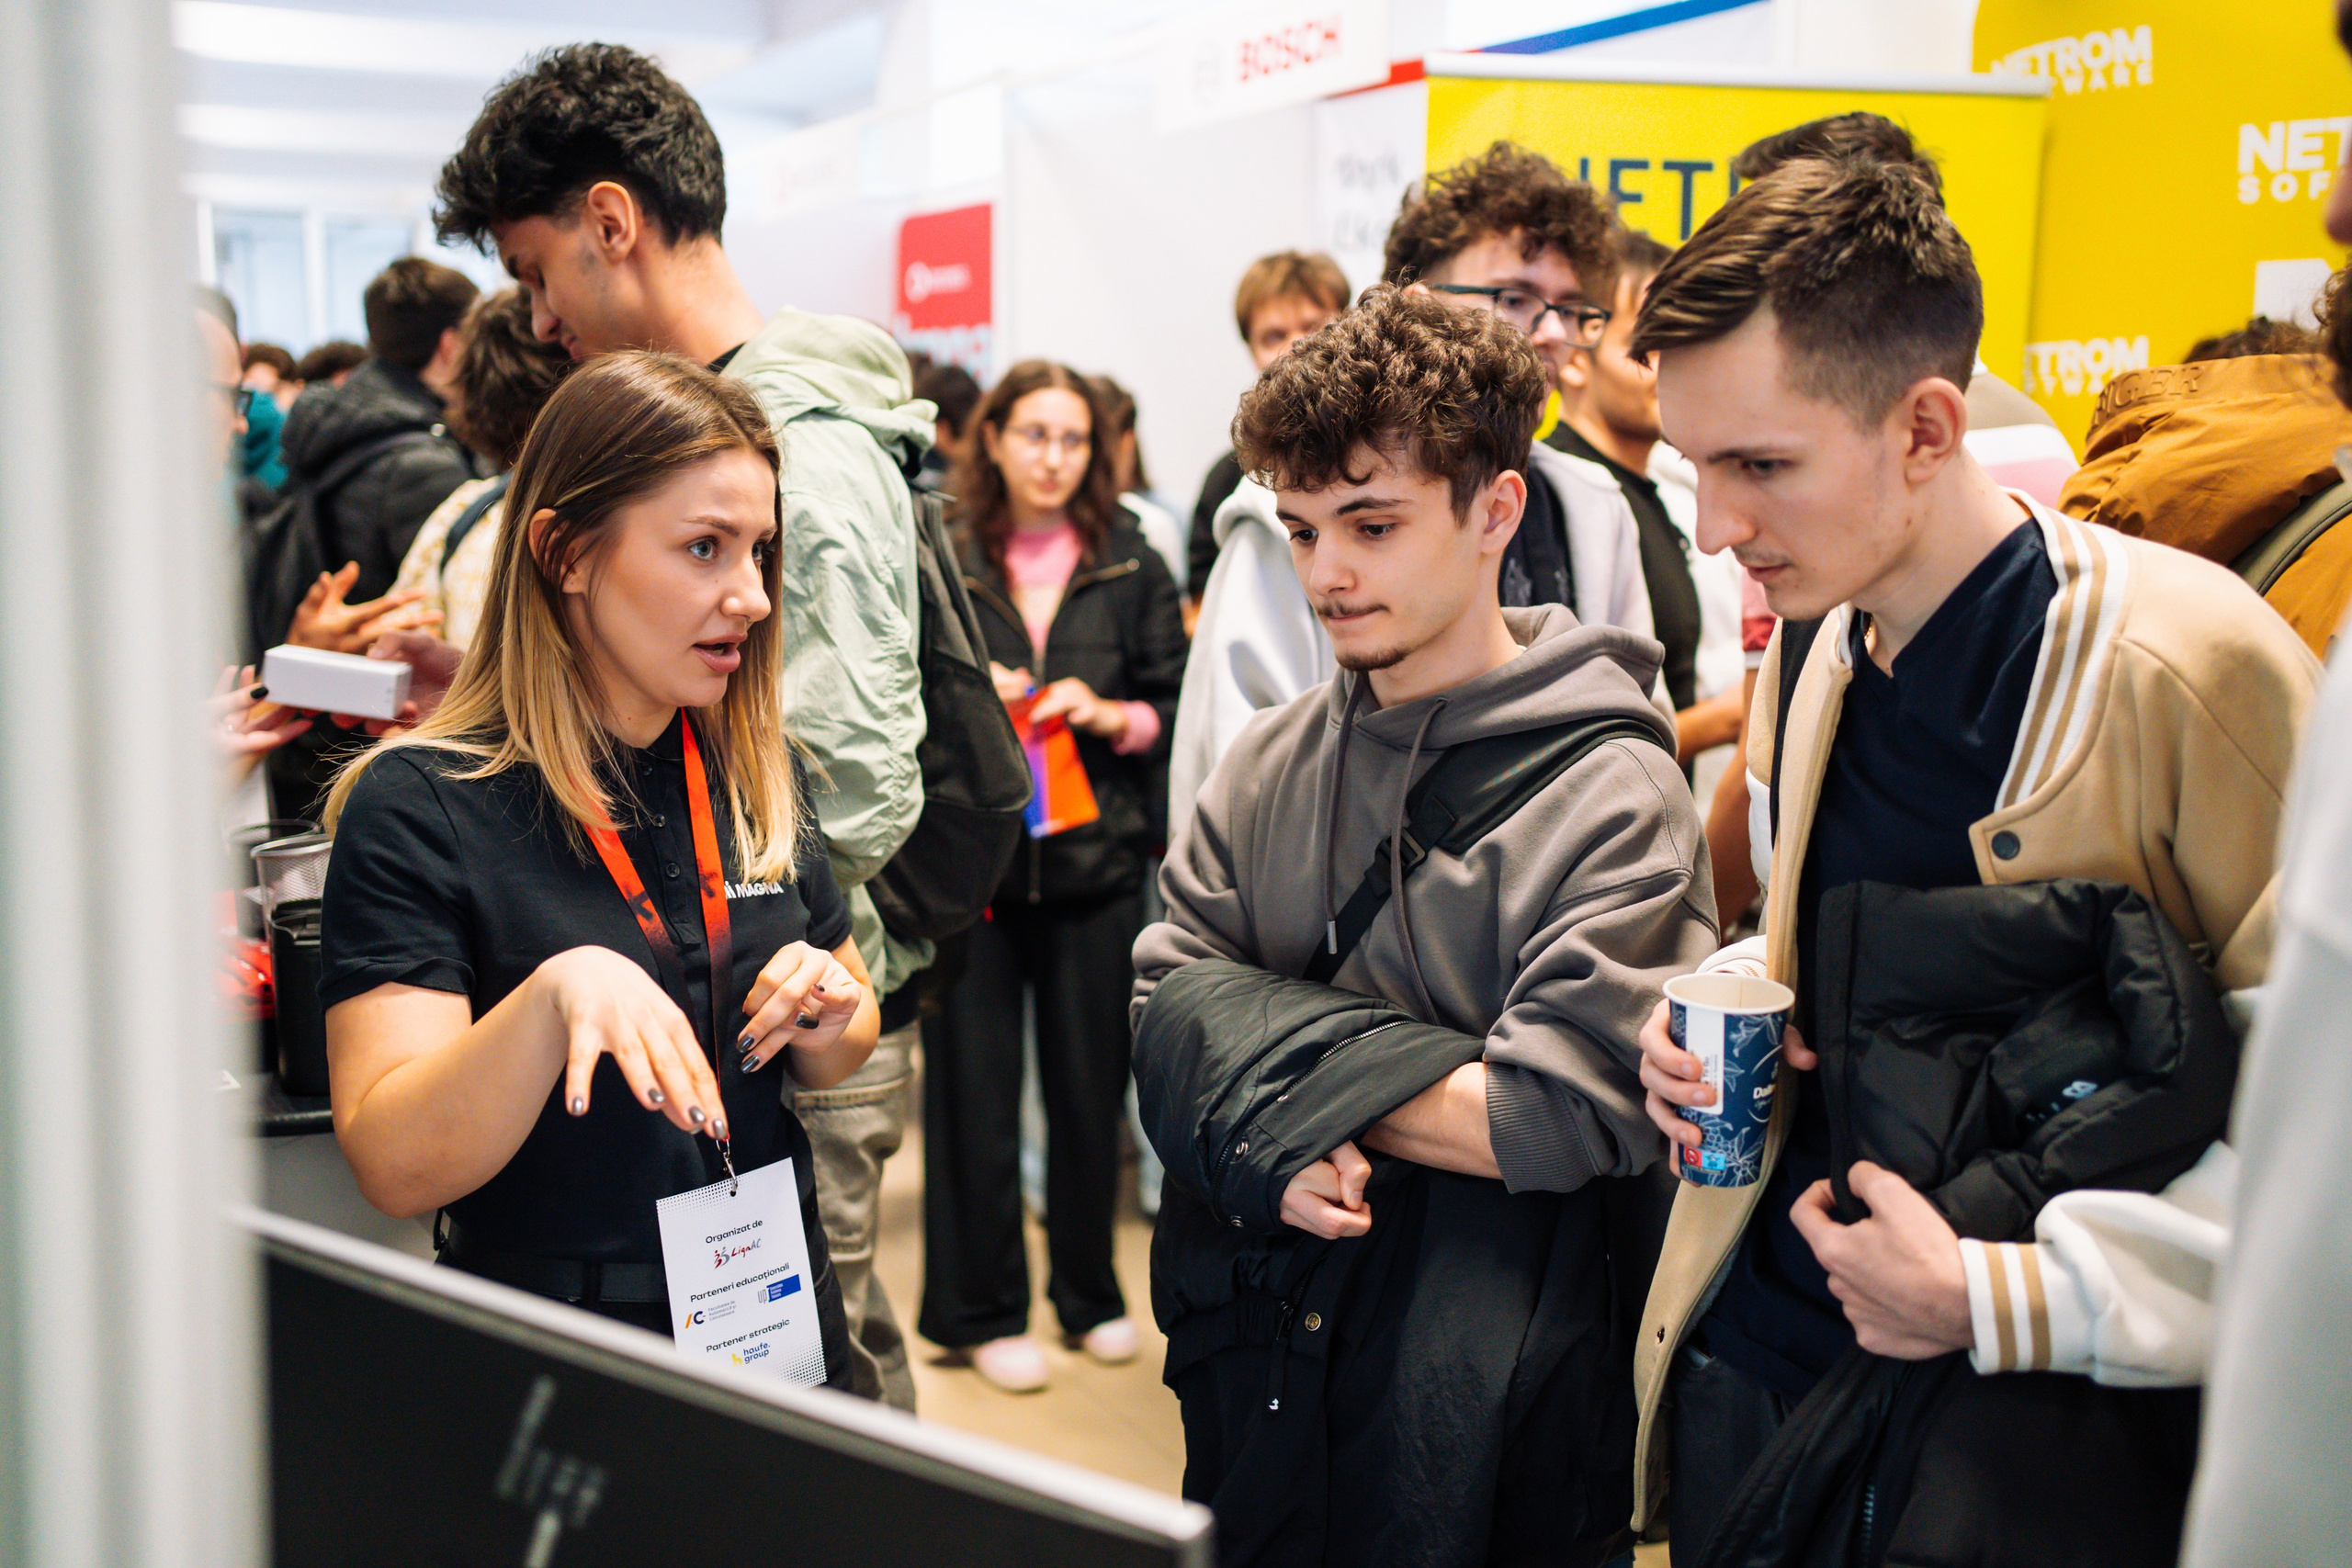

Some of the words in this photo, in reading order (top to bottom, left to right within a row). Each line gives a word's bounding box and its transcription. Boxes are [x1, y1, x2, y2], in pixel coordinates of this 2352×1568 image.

[1238, 15, 1341, 82] BOSCH
[735, 881, 785, 898] MAGNA
[706, 1224, 752, 1244] Organizat
[752, 1220, 763, 1228] de
[690, 1282, 735, 1303] Parteneri
[706, 1334, 748, 1352] Partener
[749, 1319, 790, 1339] strategic
[744, 1348, 770, 1364] group
